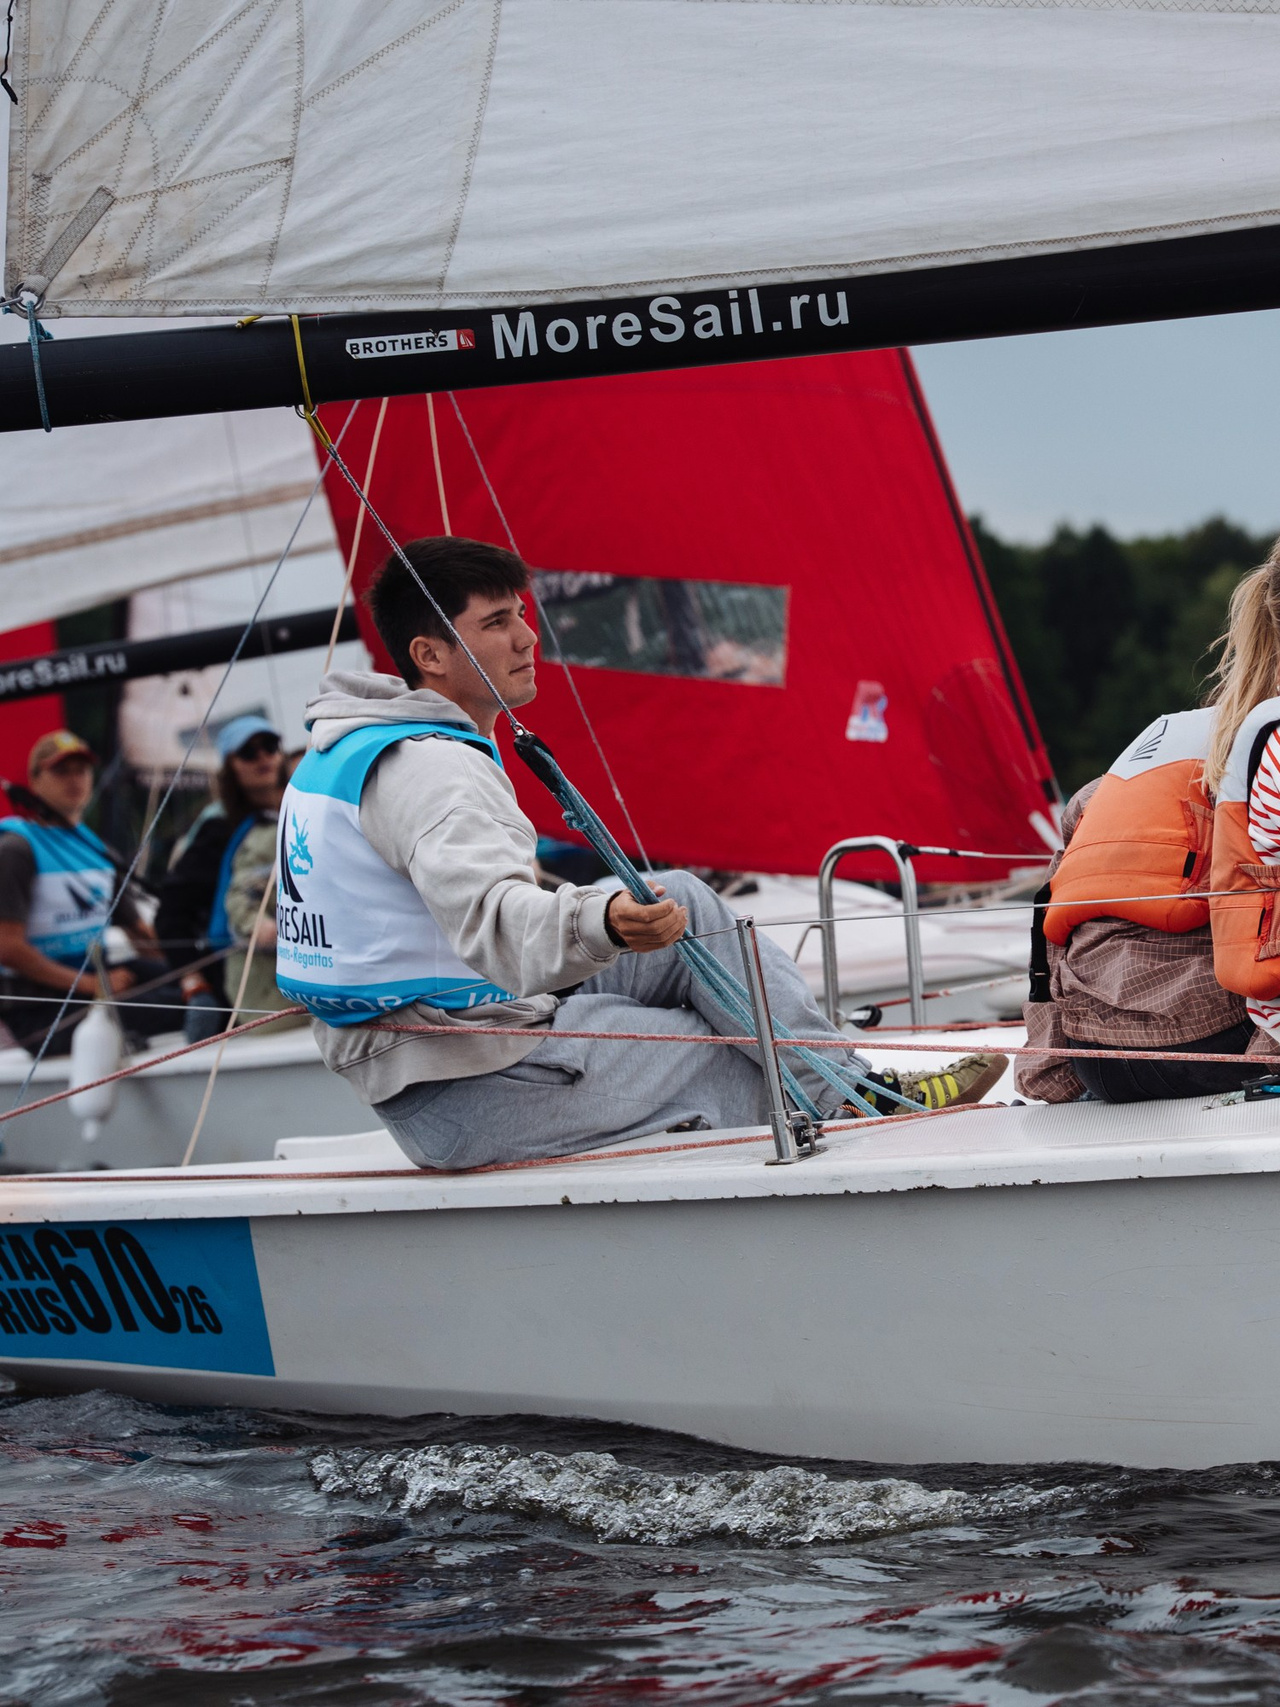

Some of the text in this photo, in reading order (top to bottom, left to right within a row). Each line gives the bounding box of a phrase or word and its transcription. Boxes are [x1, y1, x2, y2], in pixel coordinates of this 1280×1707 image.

[349, 335, 448, 355] BROTHERS
[492, 289, 850, 360] MoreSail.ru
[169, 1285, 223, 1335] 26
